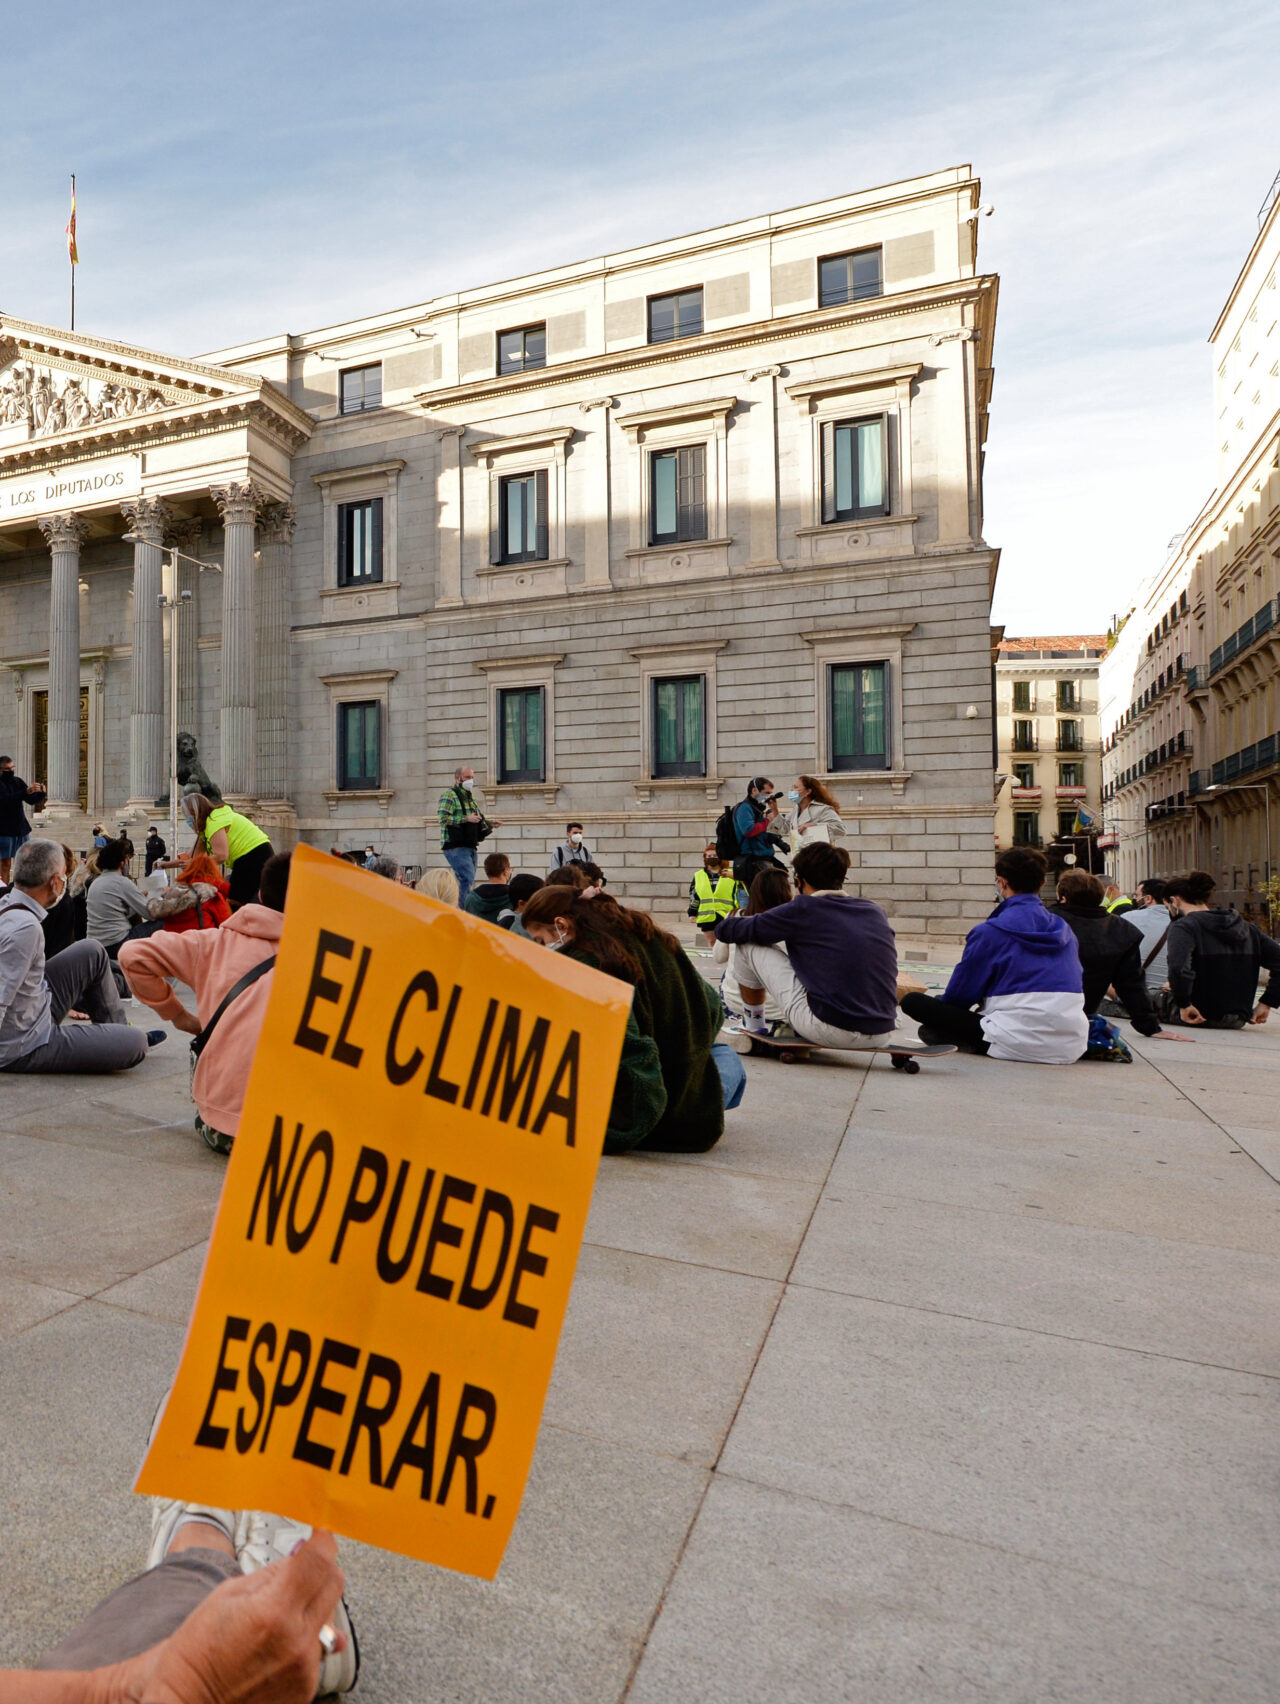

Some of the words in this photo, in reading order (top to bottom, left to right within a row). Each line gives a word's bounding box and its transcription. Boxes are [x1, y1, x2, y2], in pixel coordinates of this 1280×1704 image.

[11, 491, 35, 507] LOS
[46, 472, 124, 499] DIPUTADOS
[293, 929, 373, 1068] EL
[385, 970, 581, 1148] CLIMA
[246, 1115, 334, 1255] NO
[329, 1145, 560, 1331] PUEDE
[193, 1316, 498, 1520] ESPERAR.
